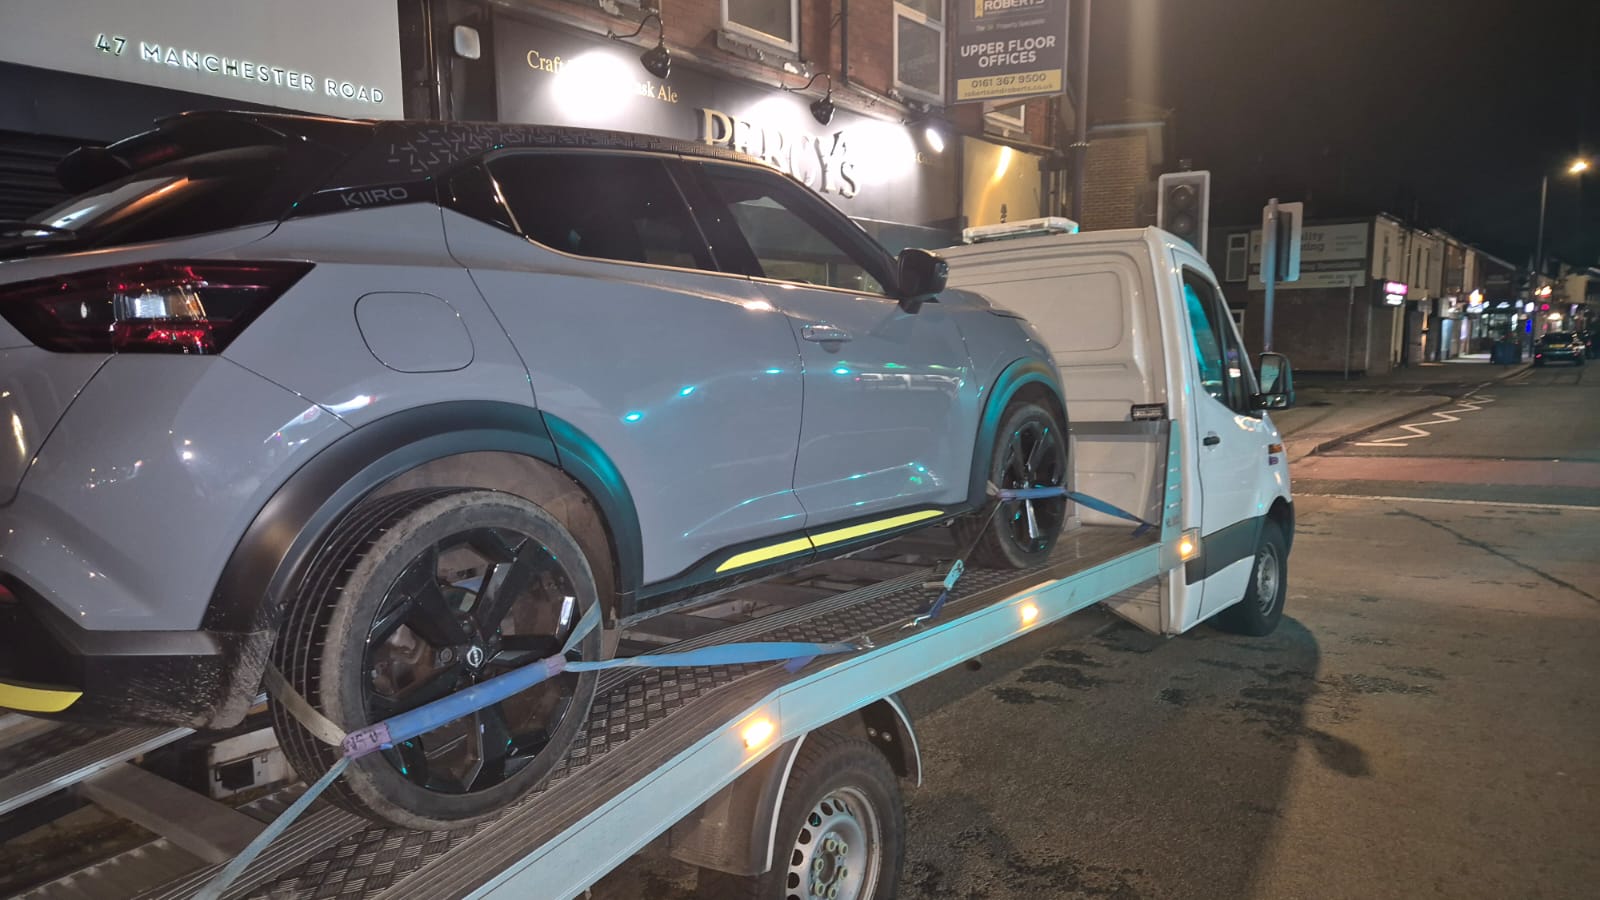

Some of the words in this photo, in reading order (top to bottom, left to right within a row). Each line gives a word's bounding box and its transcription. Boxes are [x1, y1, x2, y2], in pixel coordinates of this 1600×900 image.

[960, 41, 1005, 58] UPPER
[1008, 35, 1056, 52] FLOOR
[95, 33, 127, 56] 47
[140, 41, 315, 92] MANCHESTER
[325, 78, 384, 104] ROAD
[978, 51, 1037, 68] OFFICES
[971, 79, 993, 89] 0161
[996, 76, 1016, 86] 367
[1018, 72, 1047, 84] 9500
[657, 84, 679, 103] Ale
[341, 187, 408, 206] KIIRO
